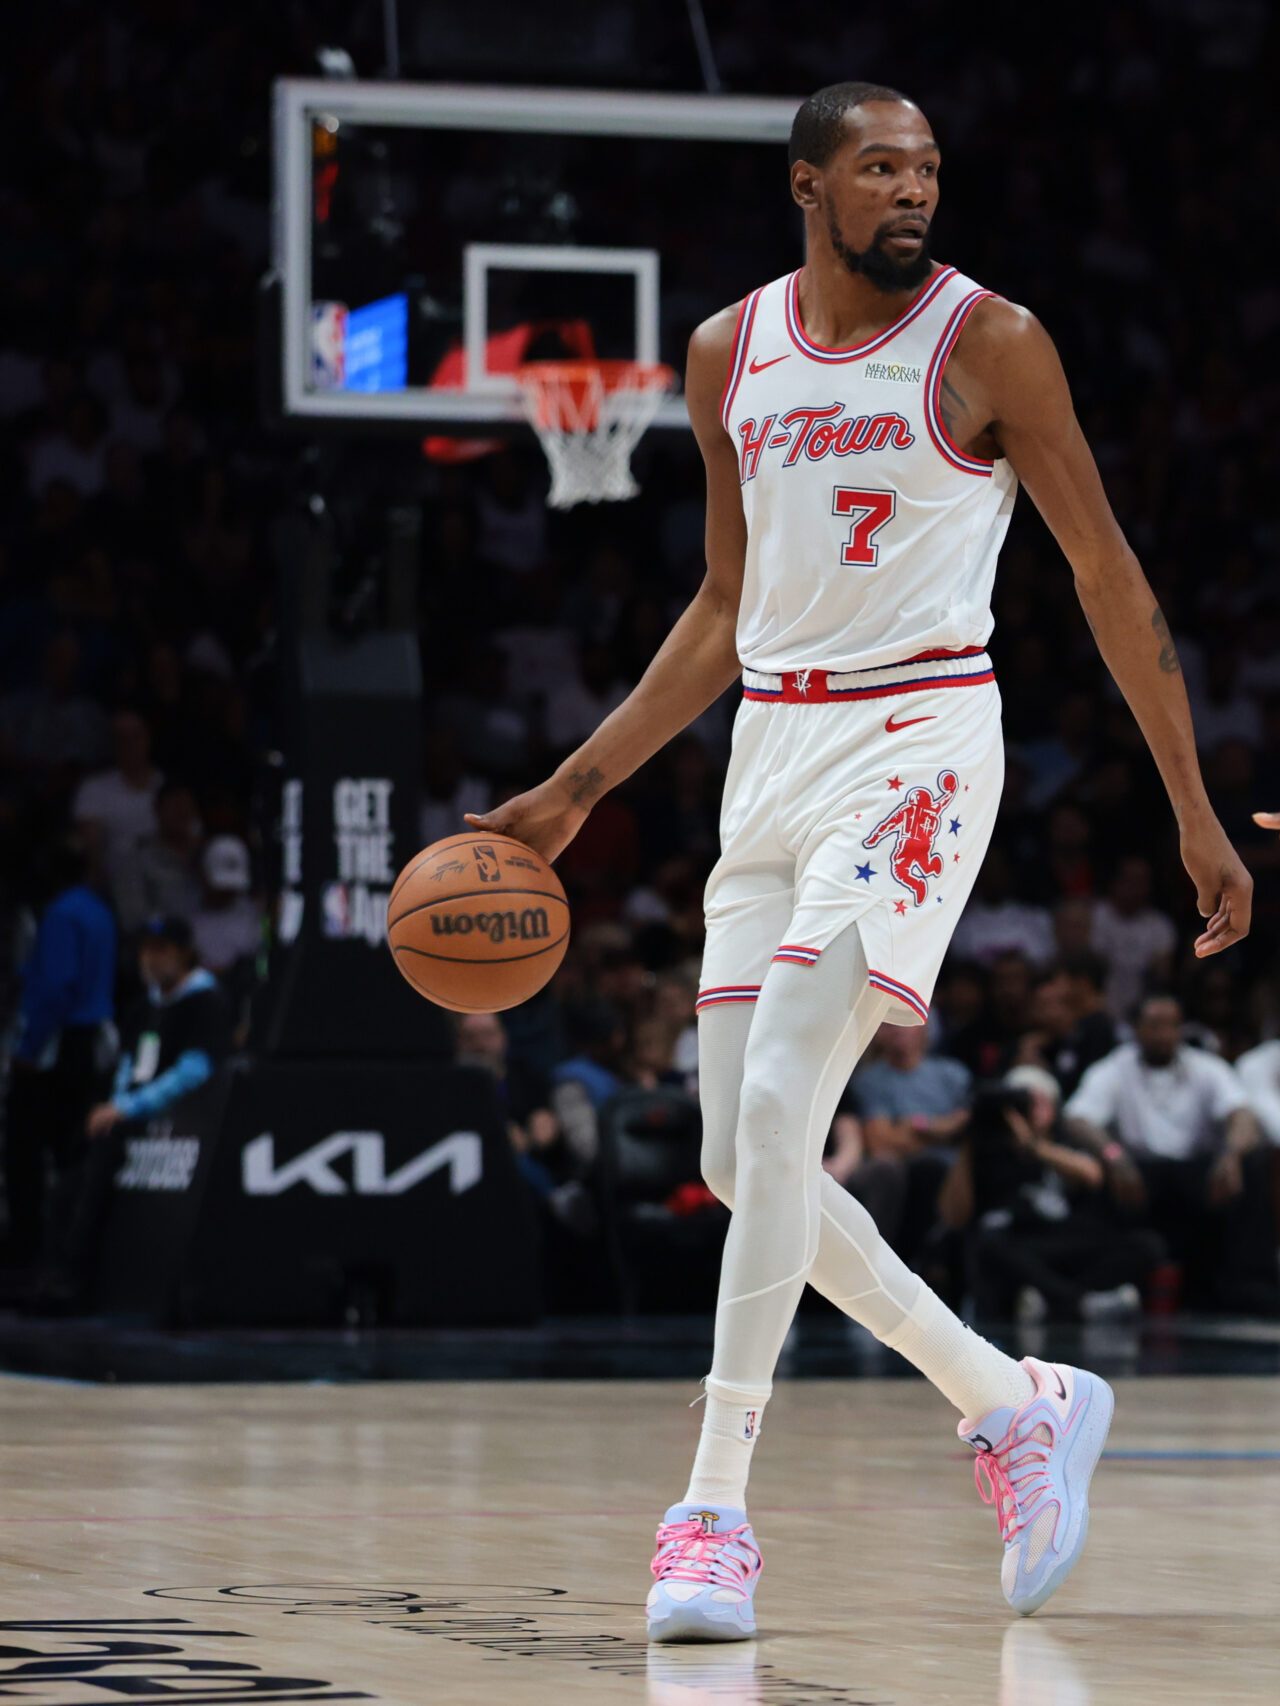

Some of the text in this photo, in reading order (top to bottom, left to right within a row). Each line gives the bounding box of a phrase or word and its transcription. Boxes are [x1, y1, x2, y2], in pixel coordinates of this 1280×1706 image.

[864, 369, 921, 384] HERMANN
[865, 363, 922, 377] MEMORIAL
[738, 401, 916, 487] H-Town
[831, 485, 896, 567] 7
[333, 777, 394, 828] GET
[334, 832, 394, 884] THE
[430, 907, 550, 944] Wilson
